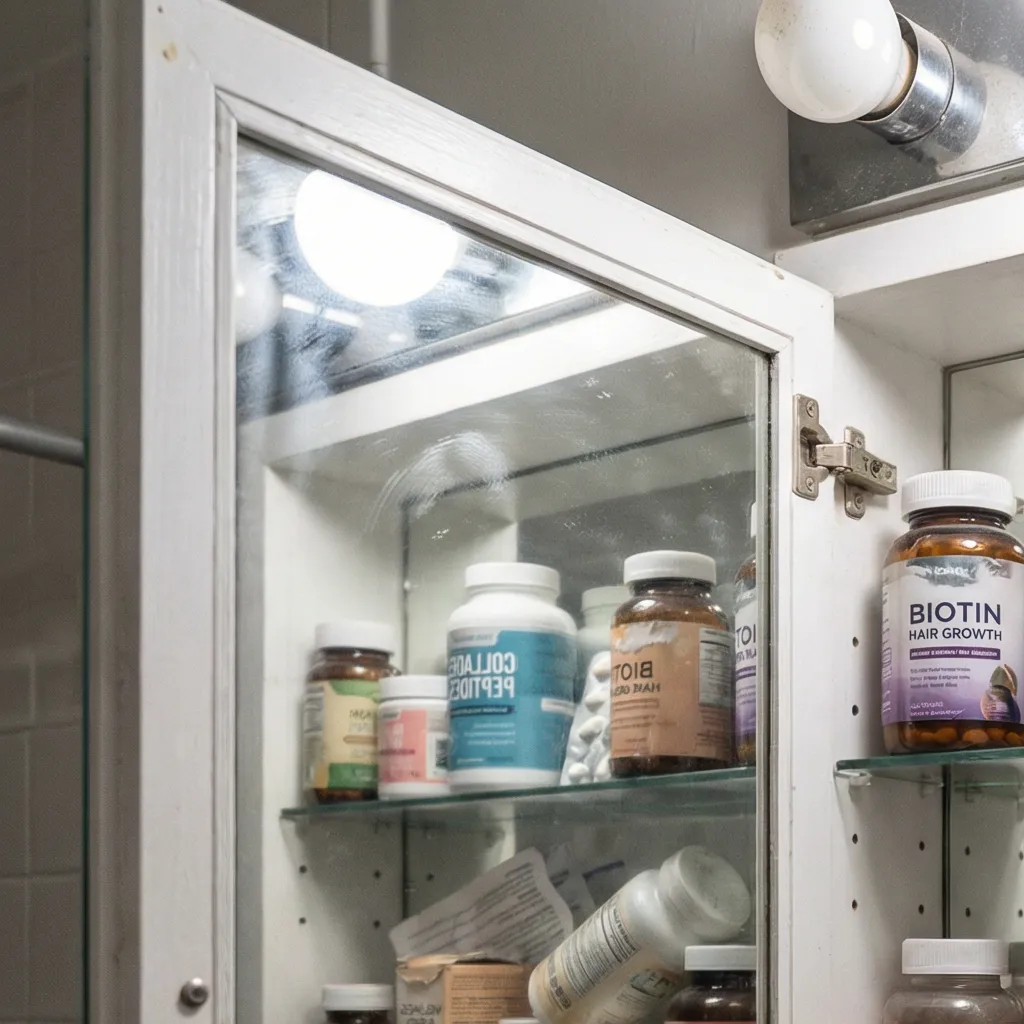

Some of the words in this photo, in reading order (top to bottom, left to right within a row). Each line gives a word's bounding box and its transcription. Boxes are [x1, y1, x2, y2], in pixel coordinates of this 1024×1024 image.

[910, 602, 1001, 625] BIOTIN
[909, 628, 938, 641] HAIR
[942, 627, 1002, 641] GROWTH
